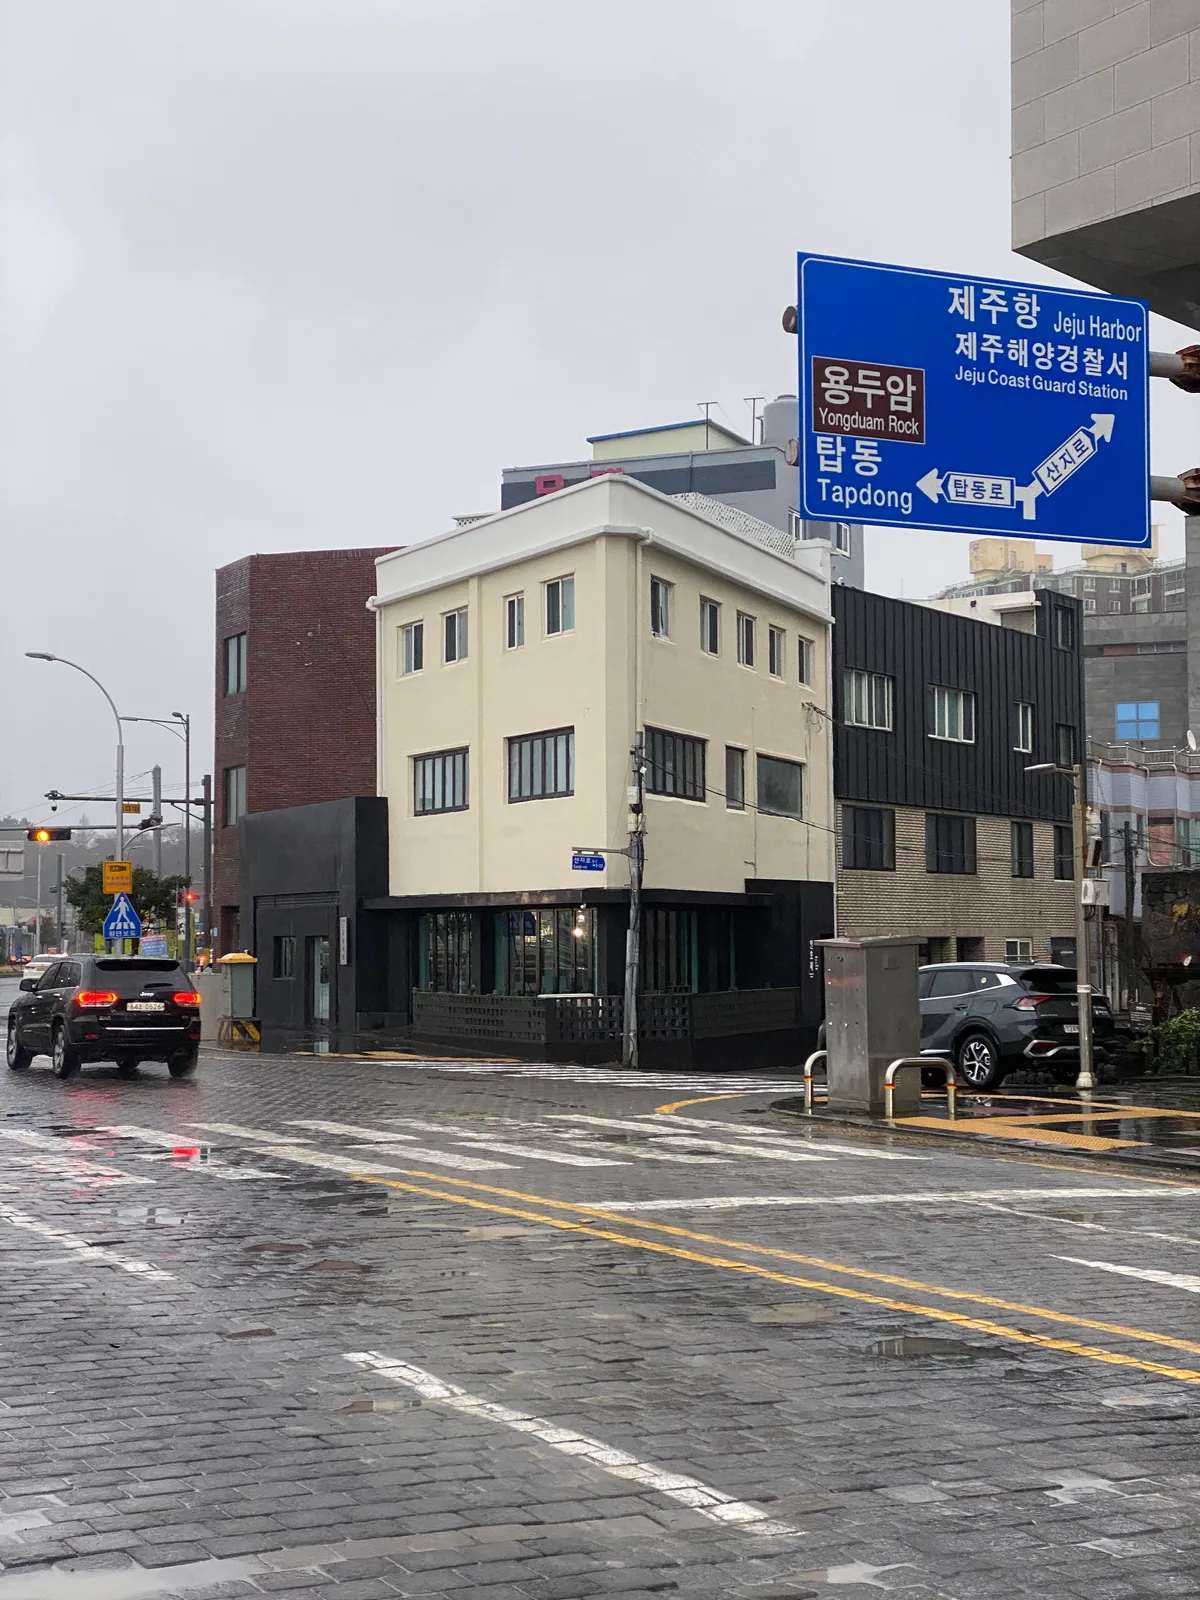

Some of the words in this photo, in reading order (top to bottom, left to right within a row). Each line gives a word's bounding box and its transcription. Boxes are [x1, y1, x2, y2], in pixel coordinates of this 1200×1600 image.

[948, 286, 1040, 329] 제주항
[1054, 311, 1085, 340] Jeju
[1090, 315, 1142, 342] Harbor
[955, 332, 1128, 380] 제주해양경찰서
[821, 366, 917, 413] 용두암
[955, 366, 985, 386] Jeju
[988, 369, 1030, 389] Coast
[1033, 375, 1076, 394] Guard
[1078, 380, 1128, 401] Station
[819, 407, 885, 432] Yongduam
[888, 415, 919, 435] Rock
[816, 436, 882, 477] 탑동
[1045, 438, 1090, 483] 산지로
[817, 478, 912, 515] Tapdong
[954, 479, 1005, 500] 탑동로
